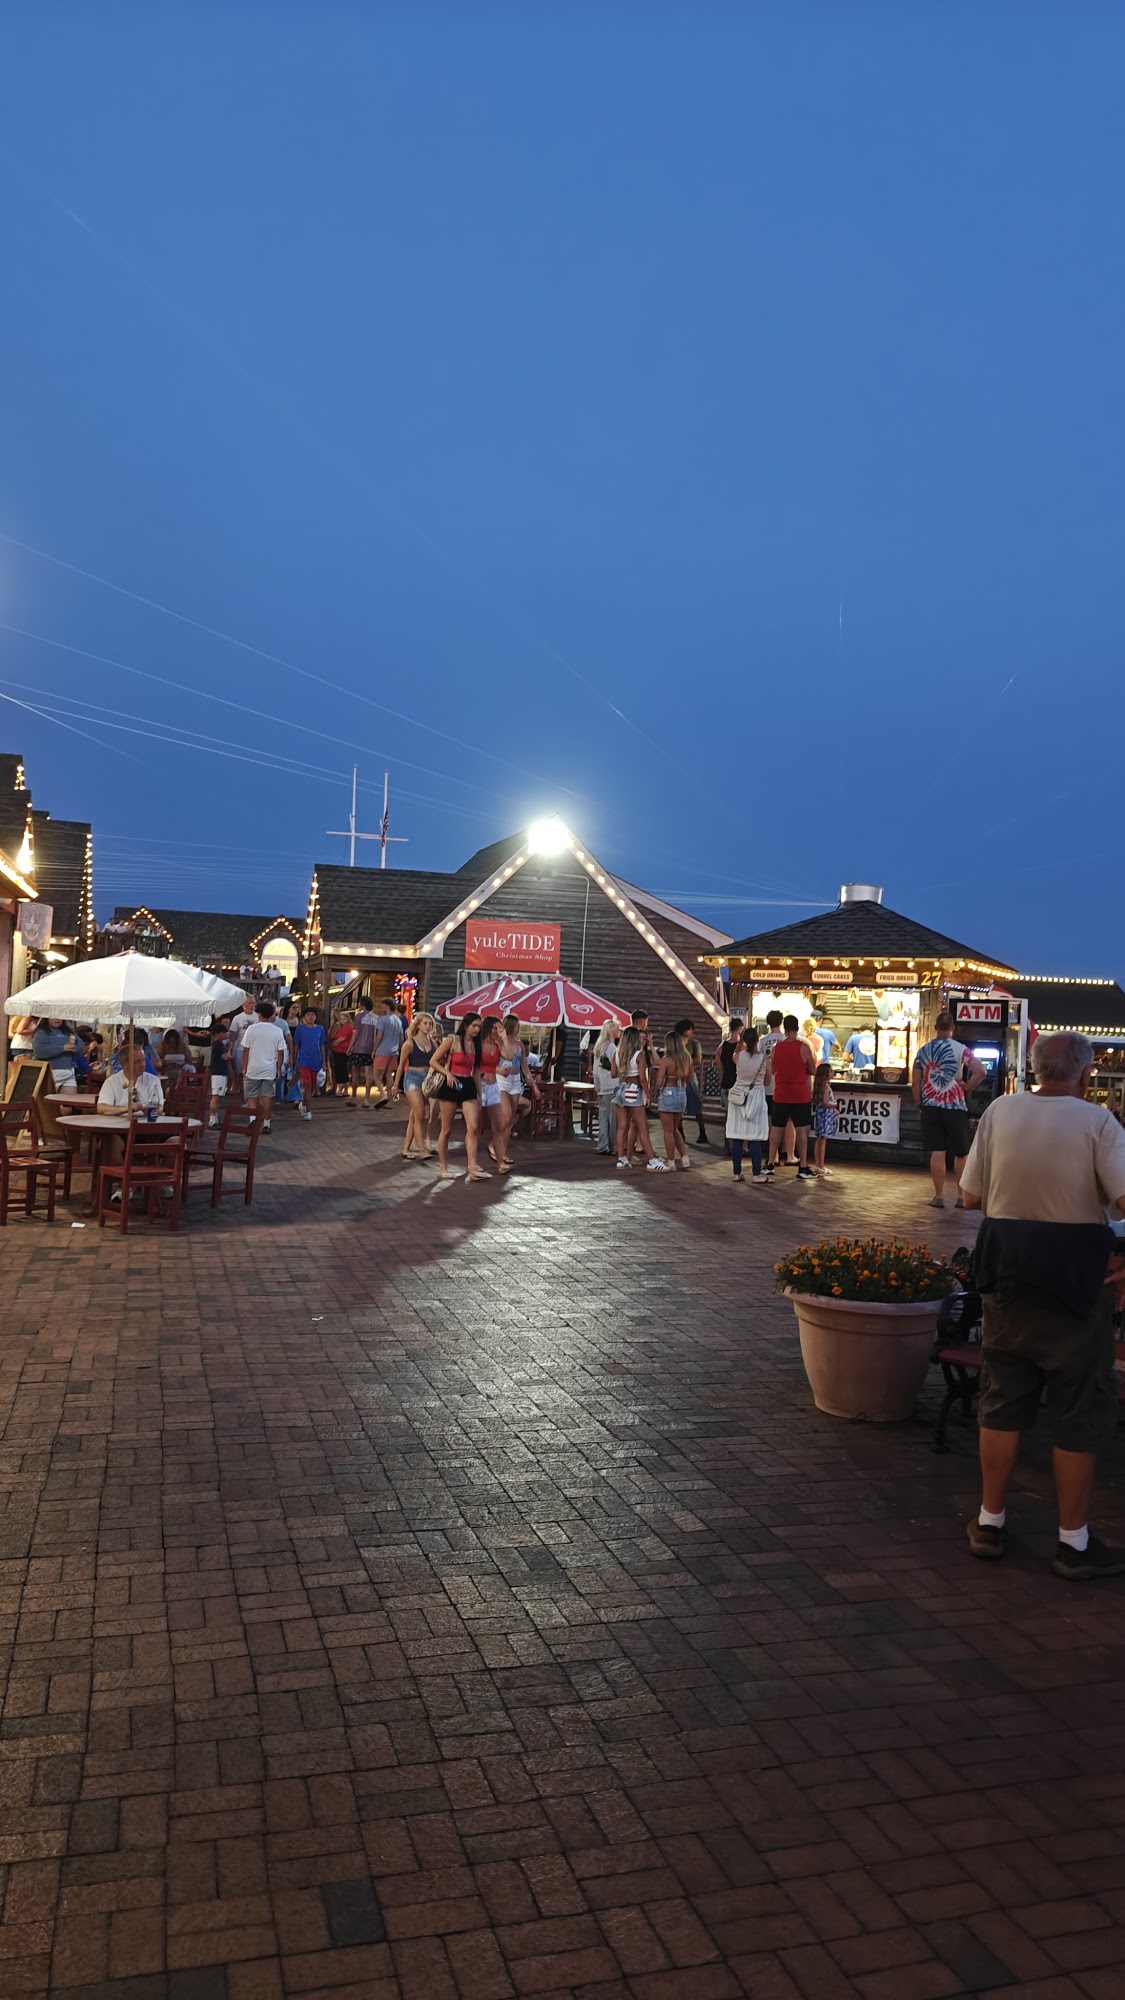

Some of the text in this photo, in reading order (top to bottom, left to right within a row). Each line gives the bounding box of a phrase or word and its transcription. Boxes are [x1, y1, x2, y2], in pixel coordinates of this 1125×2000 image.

[471, 932, 555, 953] yuleTIDE
[495, 951, 553, 962] Christmas Shop
[920, 971, 942, 987] 27
[957, 1005, 1001, 1020] ATM
[836, 1098, 891, 1118] CAKES
[838, 1117, 883, 1136] REOS
